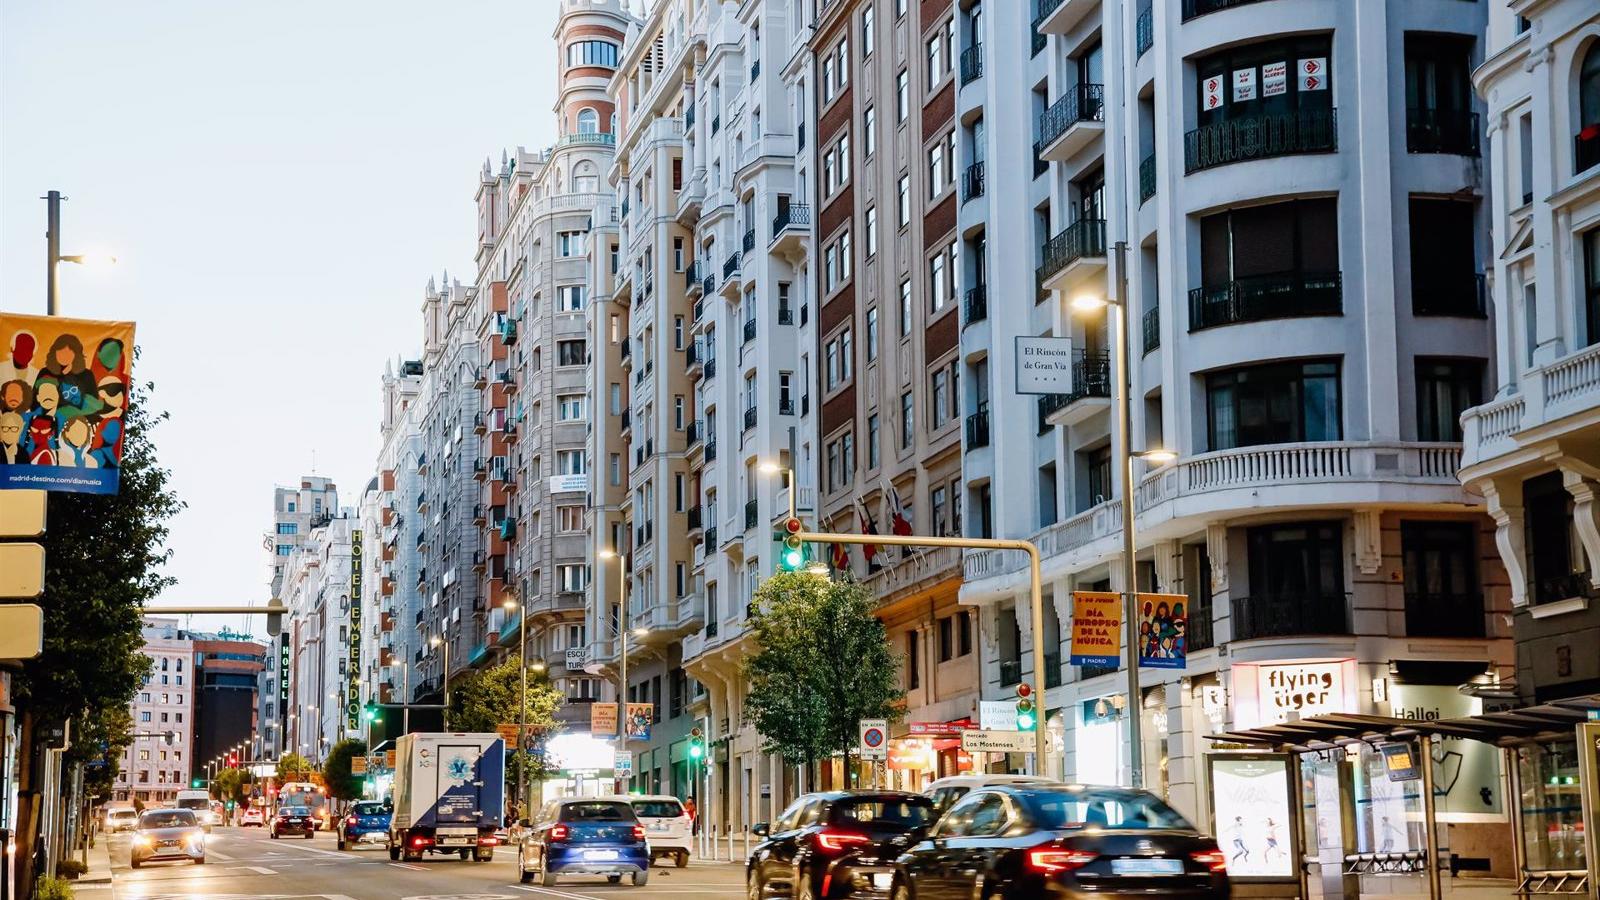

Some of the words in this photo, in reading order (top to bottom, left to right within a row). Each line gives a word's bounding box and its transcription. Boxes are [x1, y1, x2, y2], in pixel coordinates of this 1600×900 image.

[1024, 347, 1034, 355] El
[1036, 347, 1066, 356] Rincón
[1024, 361, 1033, 369] de
[1034, 361, 1053, 369] Gran
[352, 531, 362, 599] HOTEL
[1086, 608, 1104, 617] DÍA
[1075, 619, 1119, 627] EUROPEO
[1077, 635, 1113, 645] MÚSICA
[349, 607, 361, 729] EMPERADOR
[1269, 669, 1332, 690] flying
[1275, 689, 1329, 710] tiger
